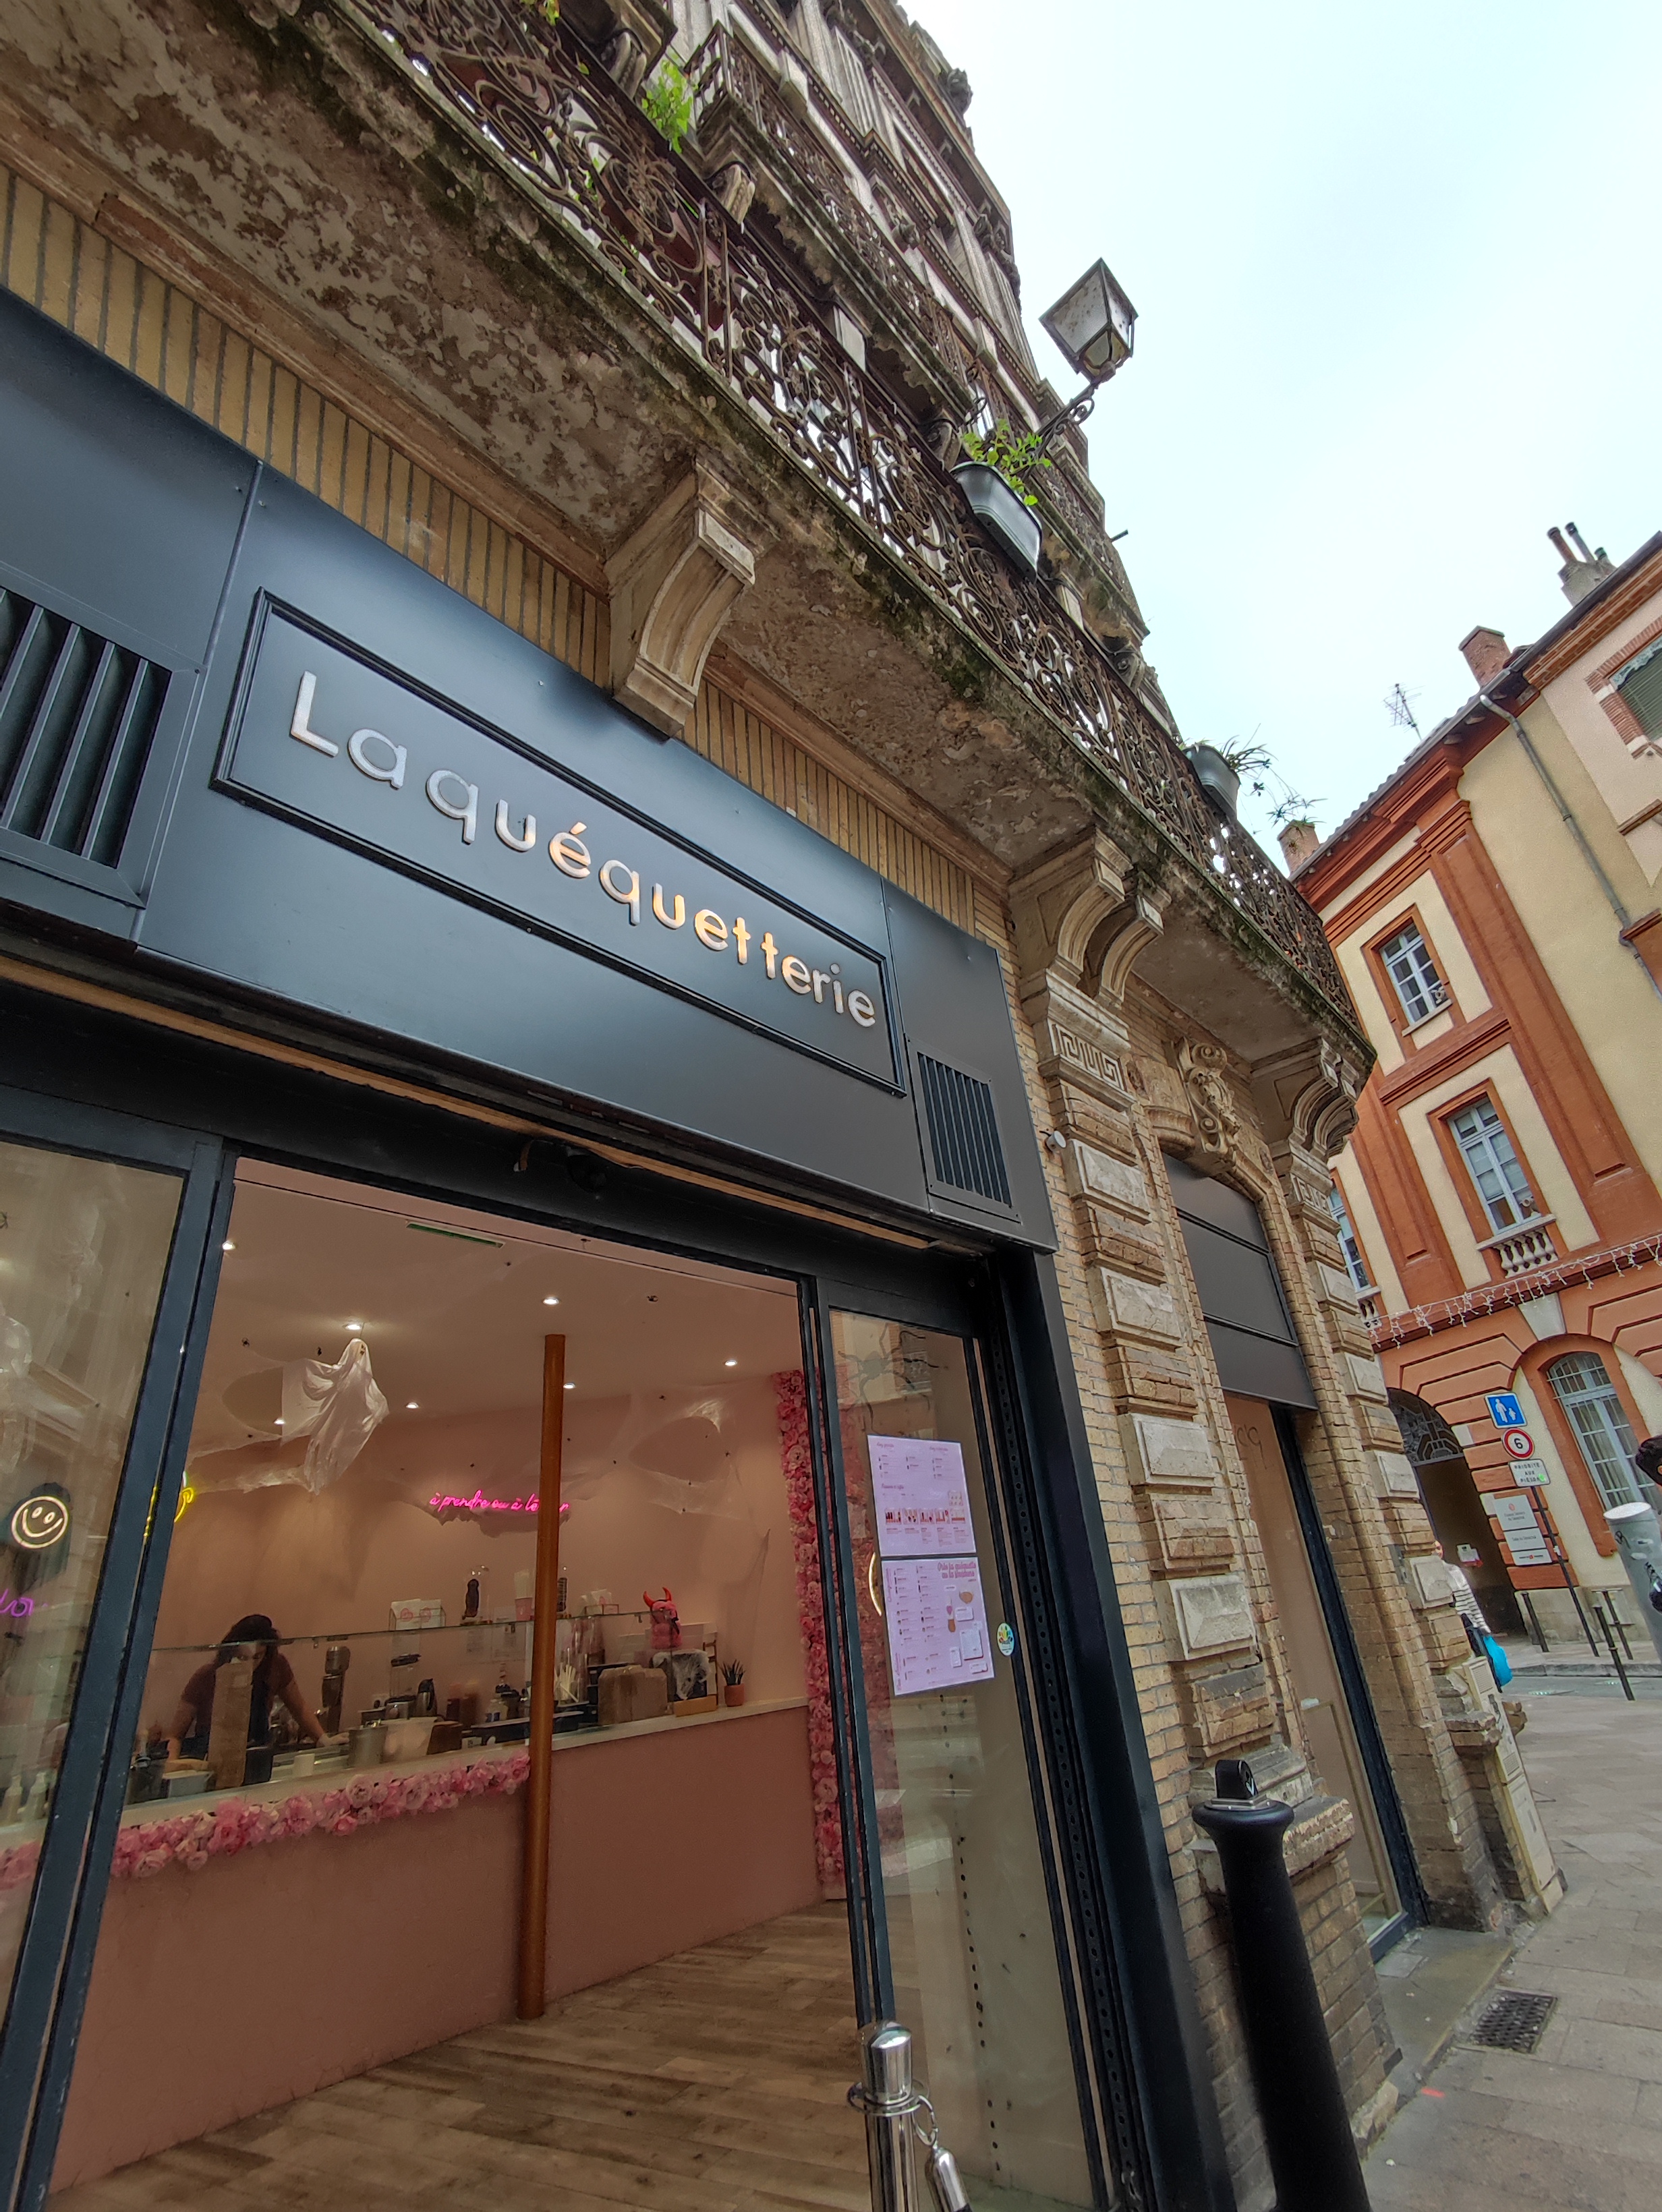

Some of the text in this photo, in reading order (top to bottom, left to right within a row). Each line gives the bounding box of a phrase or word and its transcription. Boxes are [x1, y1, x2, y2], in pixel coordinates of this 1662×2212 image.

[1514, 1438, 1523, 1449] 6
[438, 1490, 490, 1513] prendre
[491, 1499, 509, 1510] ou
[511, 1497, 523, 1511] à
